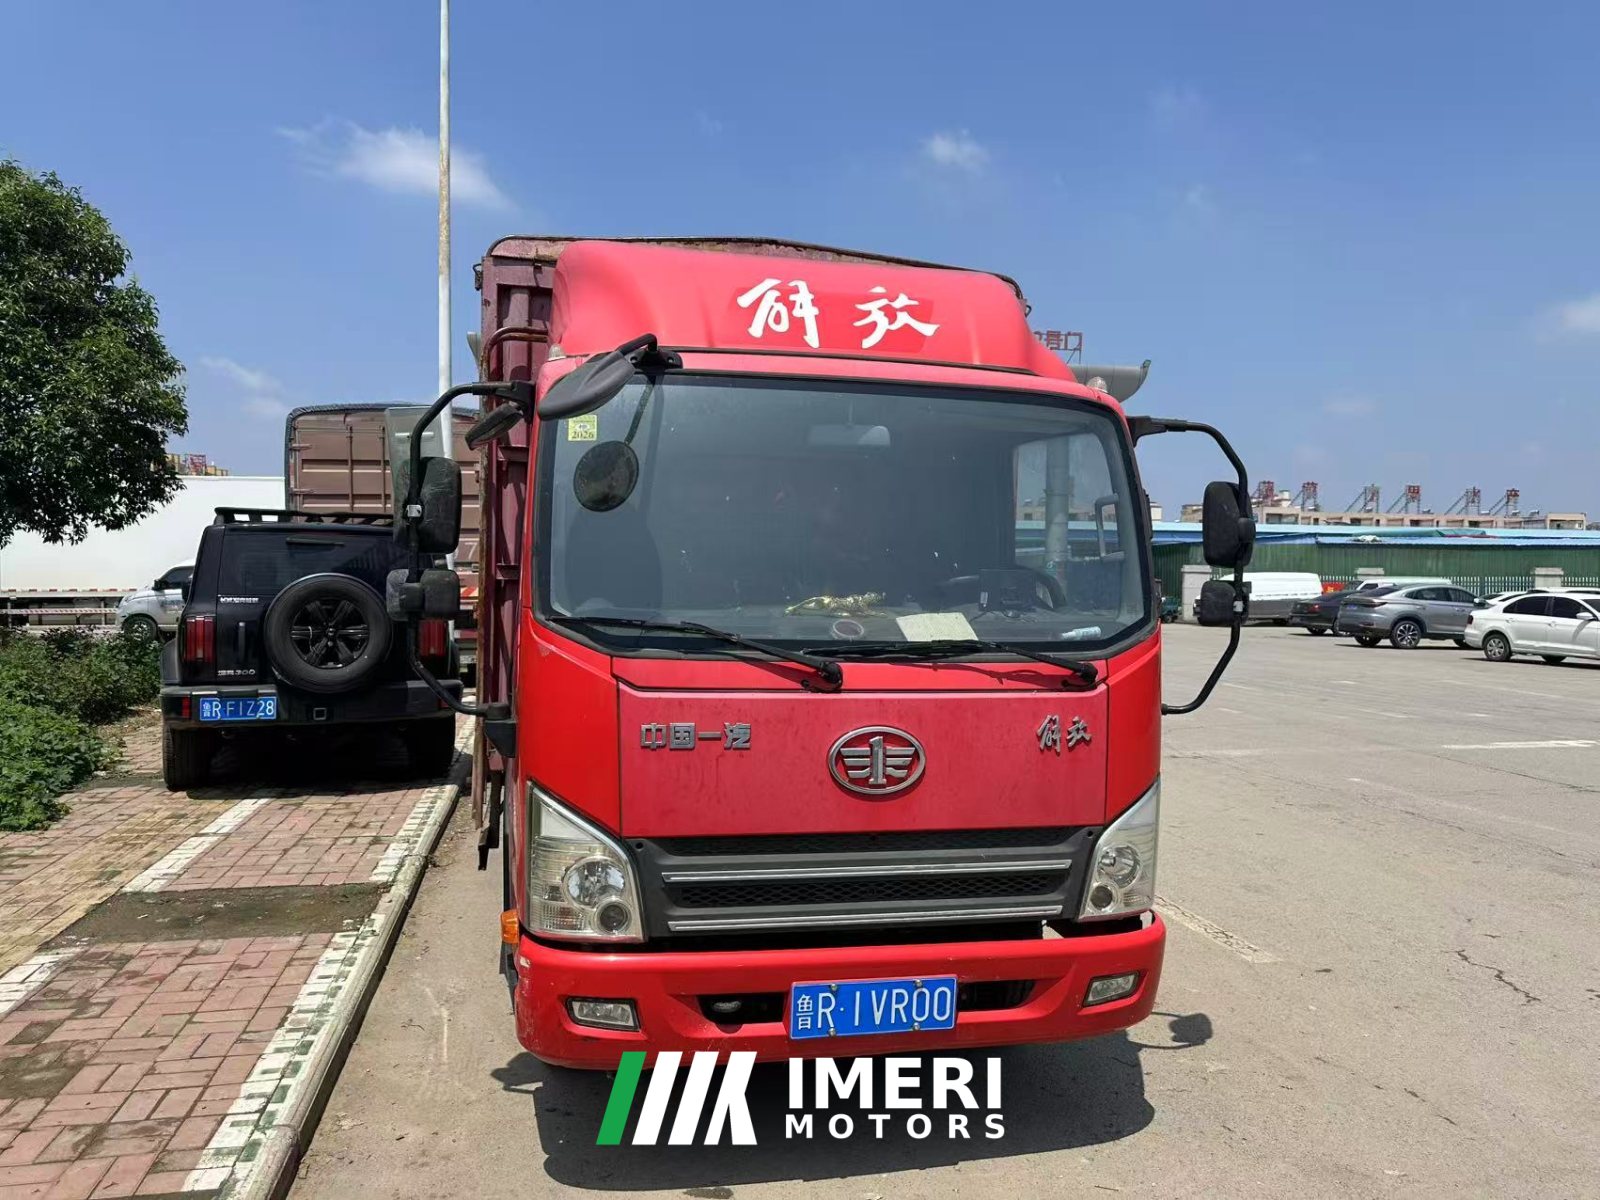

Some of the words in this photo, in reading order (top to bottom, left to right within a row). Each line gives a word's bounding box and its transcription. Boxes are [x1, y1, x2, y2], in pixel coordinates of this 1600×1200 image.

[736, 278, 941, 349] 解放
[571, 430, 594, 439] 2026
[640, 722, 751, 750] 中国一汽
[1036, 714, 1092, 753] 解放
